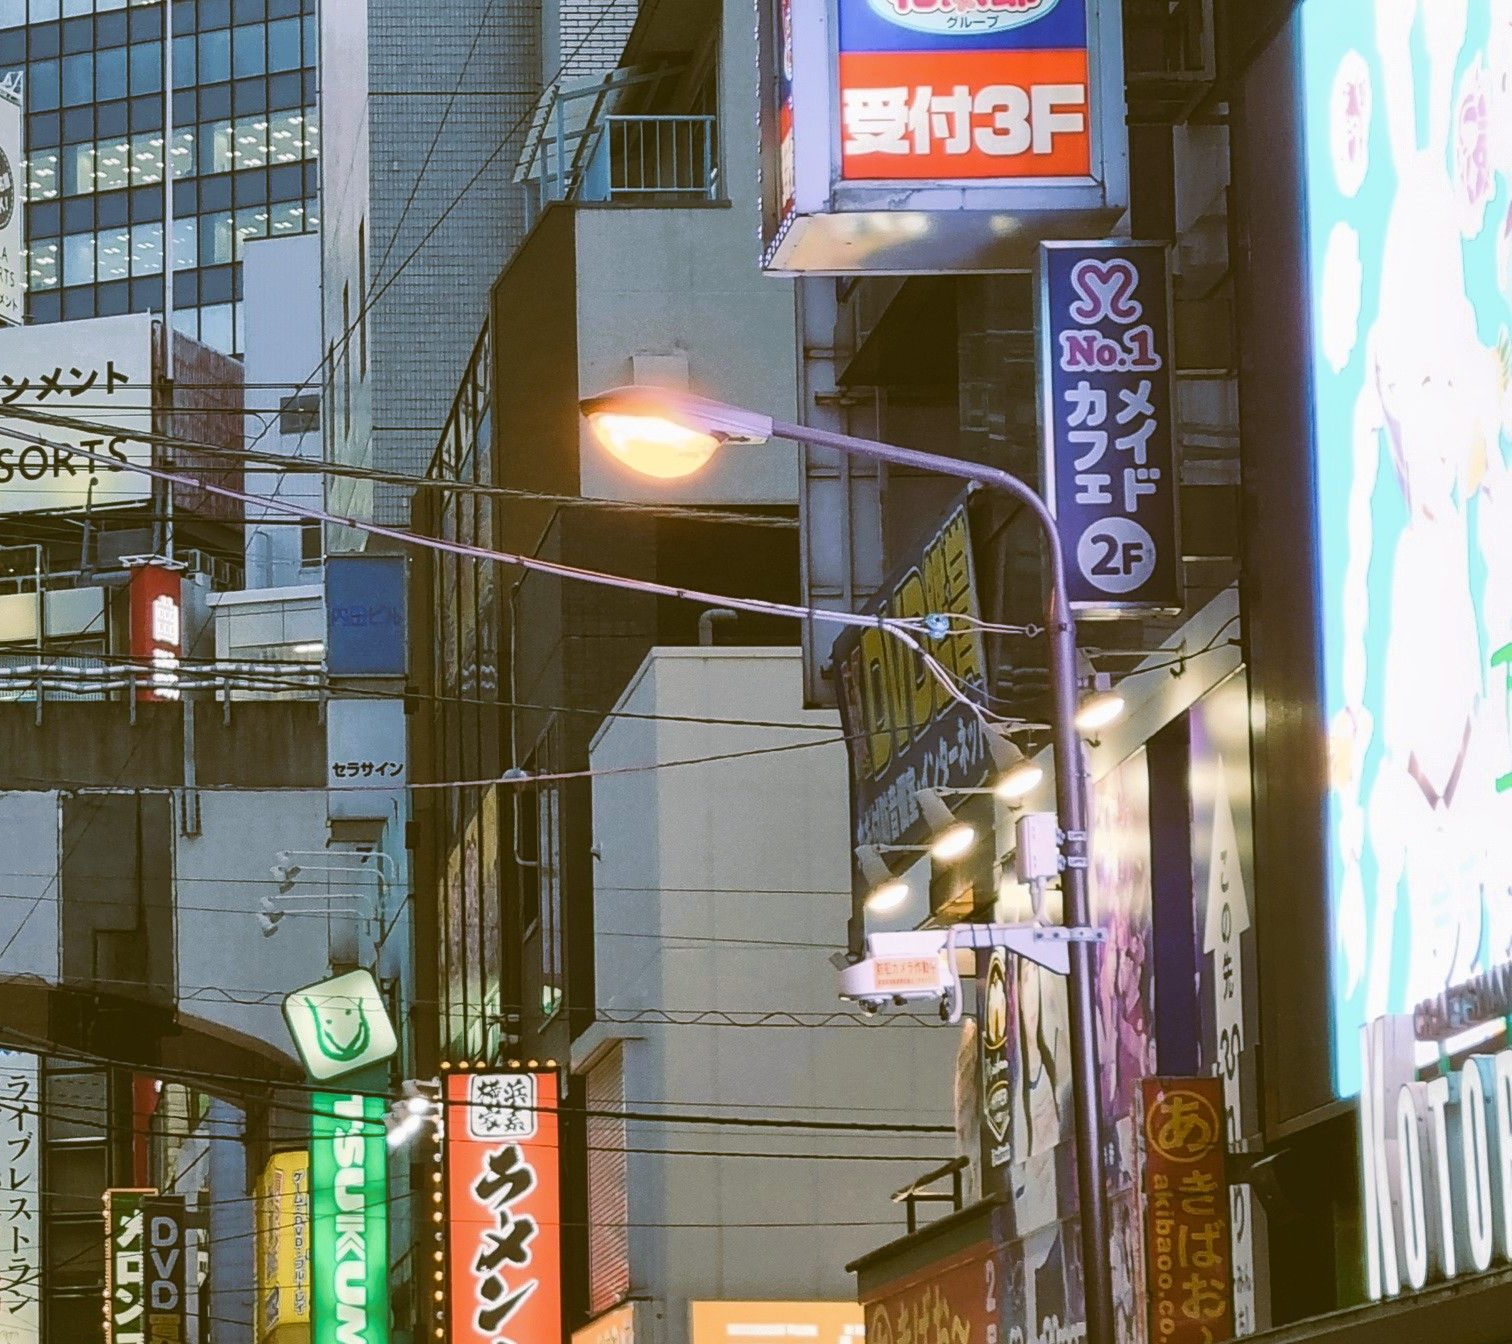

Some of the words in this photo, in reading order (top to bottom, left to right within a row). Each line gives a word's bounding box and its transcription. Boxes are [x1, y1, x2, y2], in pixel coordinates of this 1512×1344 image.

[946, 16, 998, 30] グループ
[843, 84, 1085, 156] 受付3F
[1061, 325, 1162, 372] No.1
[1064, 382, 1107, 504] カフェ
[1115, 380, 1161, 513] メイド
[1090, 533, 1144, 577] 2F
[332, 762, 403, 777] セラサイン
[7, 1074, 33, 1314] ライブレストラン
